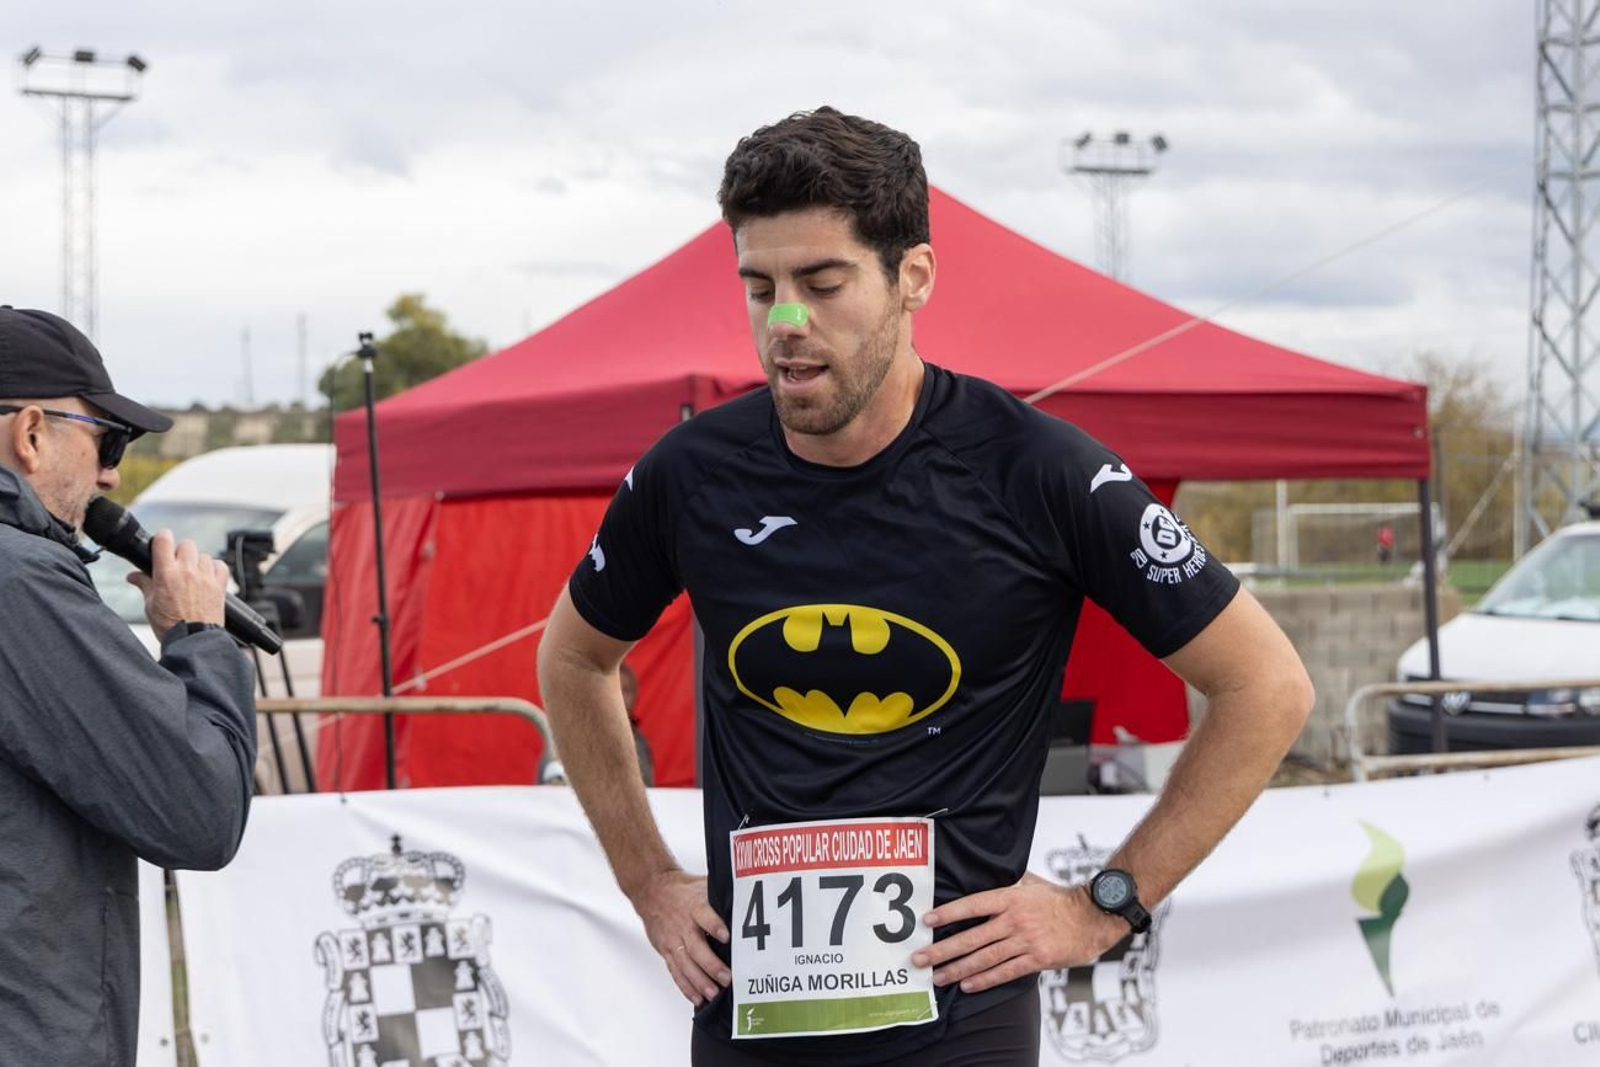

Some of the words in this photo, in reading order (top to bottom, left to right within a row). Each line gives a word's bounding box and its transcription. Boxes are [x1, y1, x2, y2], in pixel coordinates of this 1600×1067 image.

[1147, 565, 1182, 584] SUPER
[927, 726, 941, 735] TM
[753, 837, 780, 868] CROSS
[782, 832, 830, 865] POPULAR
[832, 830, 873, 862] CIUDAD
[876, 829, 892, 860] DE
[893, 828, 923, 859] JAEN
[741, 872, 917, 951] 4173
[794, 953, 844, 965] IGNACIO
[748, 974, 803, 995] ZUÑIGA
[808, 968, 909, 991] MORILLAS
[1384, 1002, 1470, 1027] Municipal
[1475, 1000, 1501, 1018] de
[1320, 1041, 1400, 1065] Deportes
[1406, 1034, 1431, 1054] de
